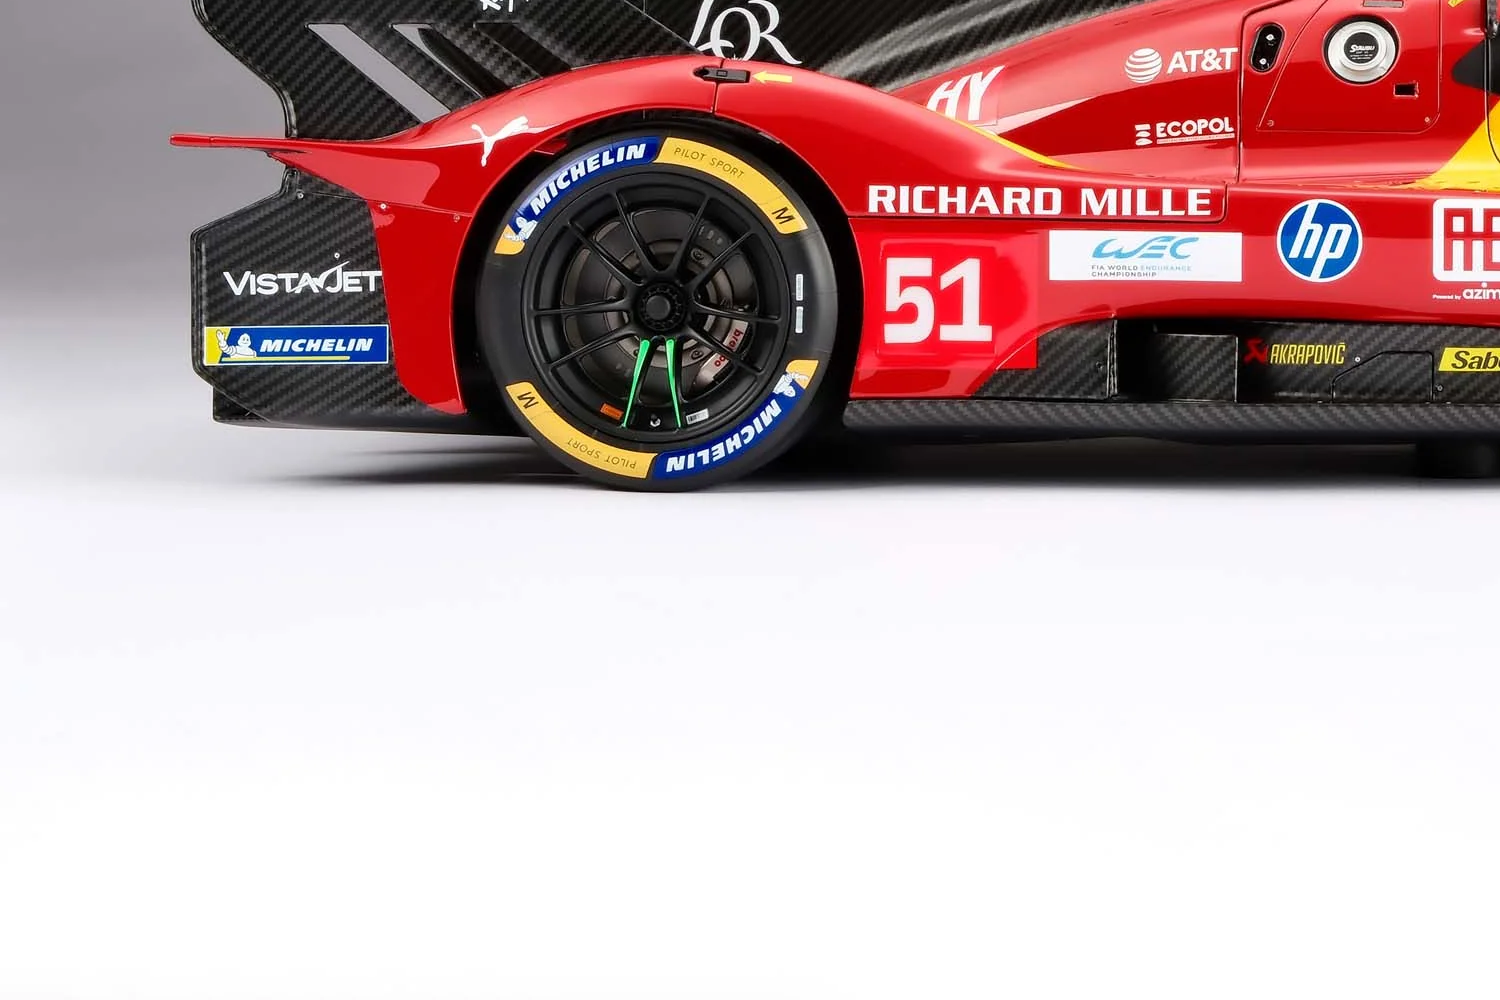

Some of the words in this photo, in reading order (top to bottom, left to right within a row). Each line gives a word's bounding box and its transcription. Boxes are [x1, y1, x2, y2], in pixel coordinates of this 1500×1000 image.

[1167, 47, 1238, 74] AT&T
[926, 65, 1005, 120] HY
[1156, 117, 1234, 138] ECOPOL
[673, 147, 706, 162] PILOT
[708, 157, 745, 178] SPORT
[530, 143, 646, 216] MICHELIN
[771, 206, 794, 225] M
[868, 185, 1062, 215] RICHARD
[1080, 188, 1211, 216] MILLE
[1288, 200, 1352, 280] hp
[884, 257, 993, 344] 51
[260, 338, 373, 353] MICHELIN
[714, 329, 744, 367] brebo
[516, 391, 539, 409] M
[567, 438, 600, 460] SPORT
[666, 399, 782, 472] MICHELIN
[603, 455, 637, 469] PILOT
